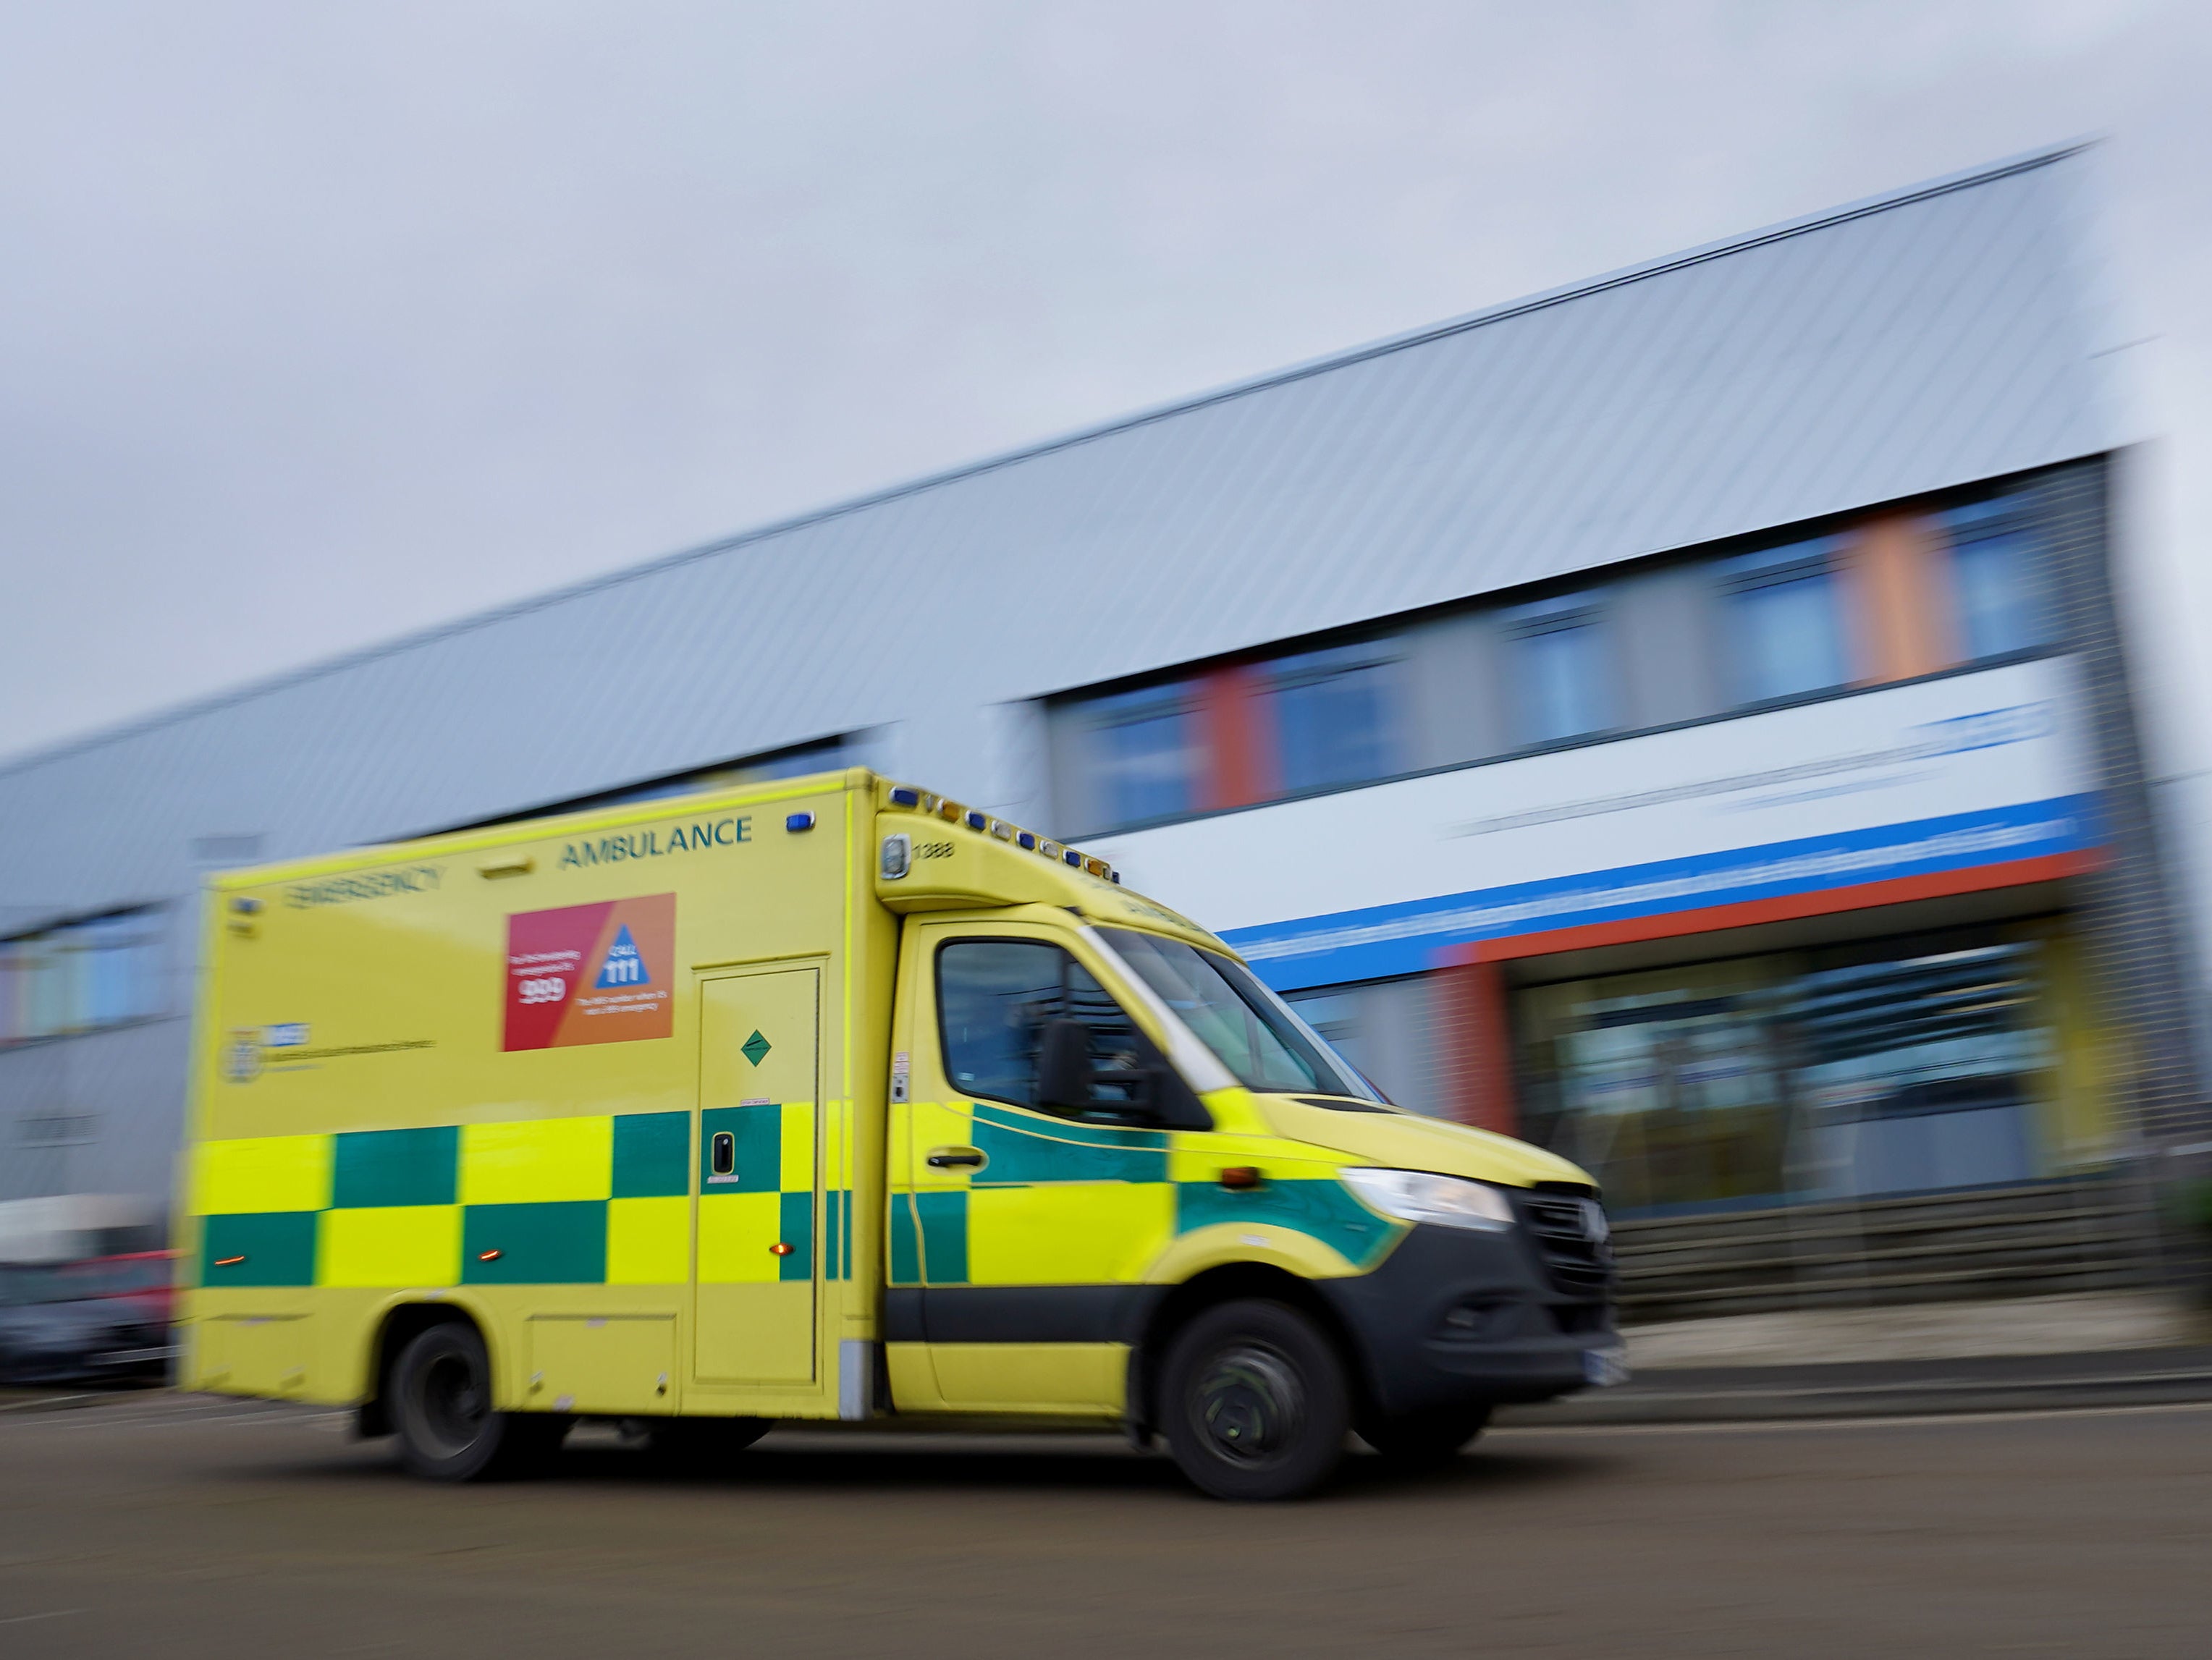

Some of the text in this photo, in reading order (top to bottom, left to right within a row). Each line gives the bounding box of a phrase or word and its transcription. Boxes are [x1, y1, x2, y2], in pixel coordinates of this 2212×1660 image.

[557, 816, 751, 871] AMBULANCE
[603, 957, 638, 983] 111
[518, 977, 566, 1004] 999
